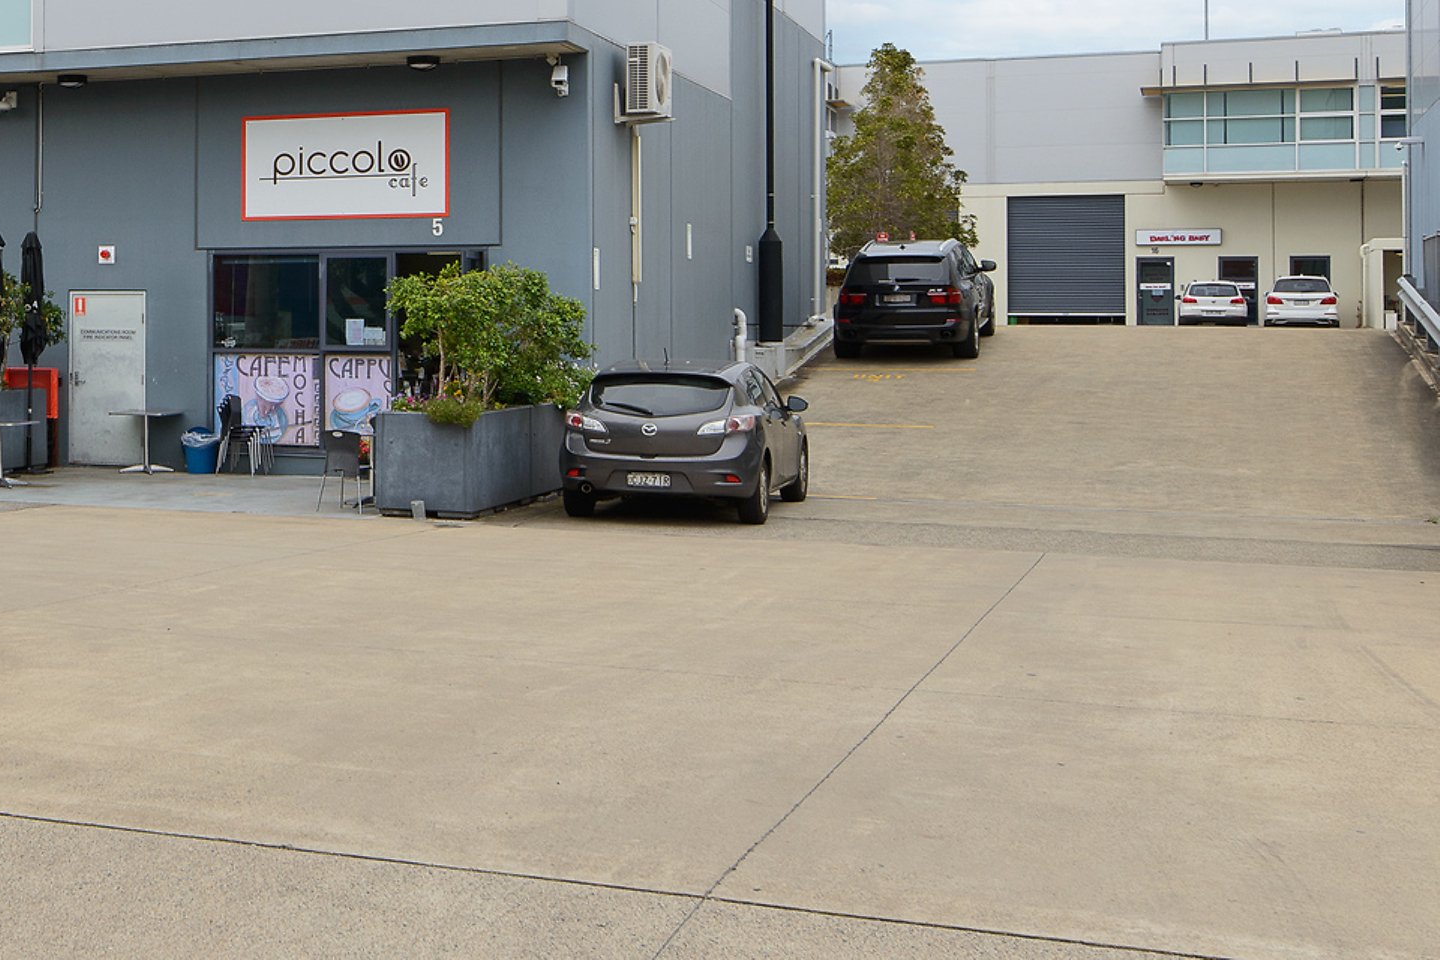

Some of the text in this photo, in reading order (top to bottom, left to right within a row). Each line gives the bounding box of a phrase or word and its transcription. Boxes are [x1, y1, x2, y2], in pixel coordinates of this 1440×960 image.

[273, 140, 411, 185] piccolo
[388, 162, 428, 197] cafe
[431, 218, 443, 236] 5
[1188, 234, 1210, 242] BABY
[236, 355, 290, 379] CAFE
[293, 356, 307, 443] MOCHA
